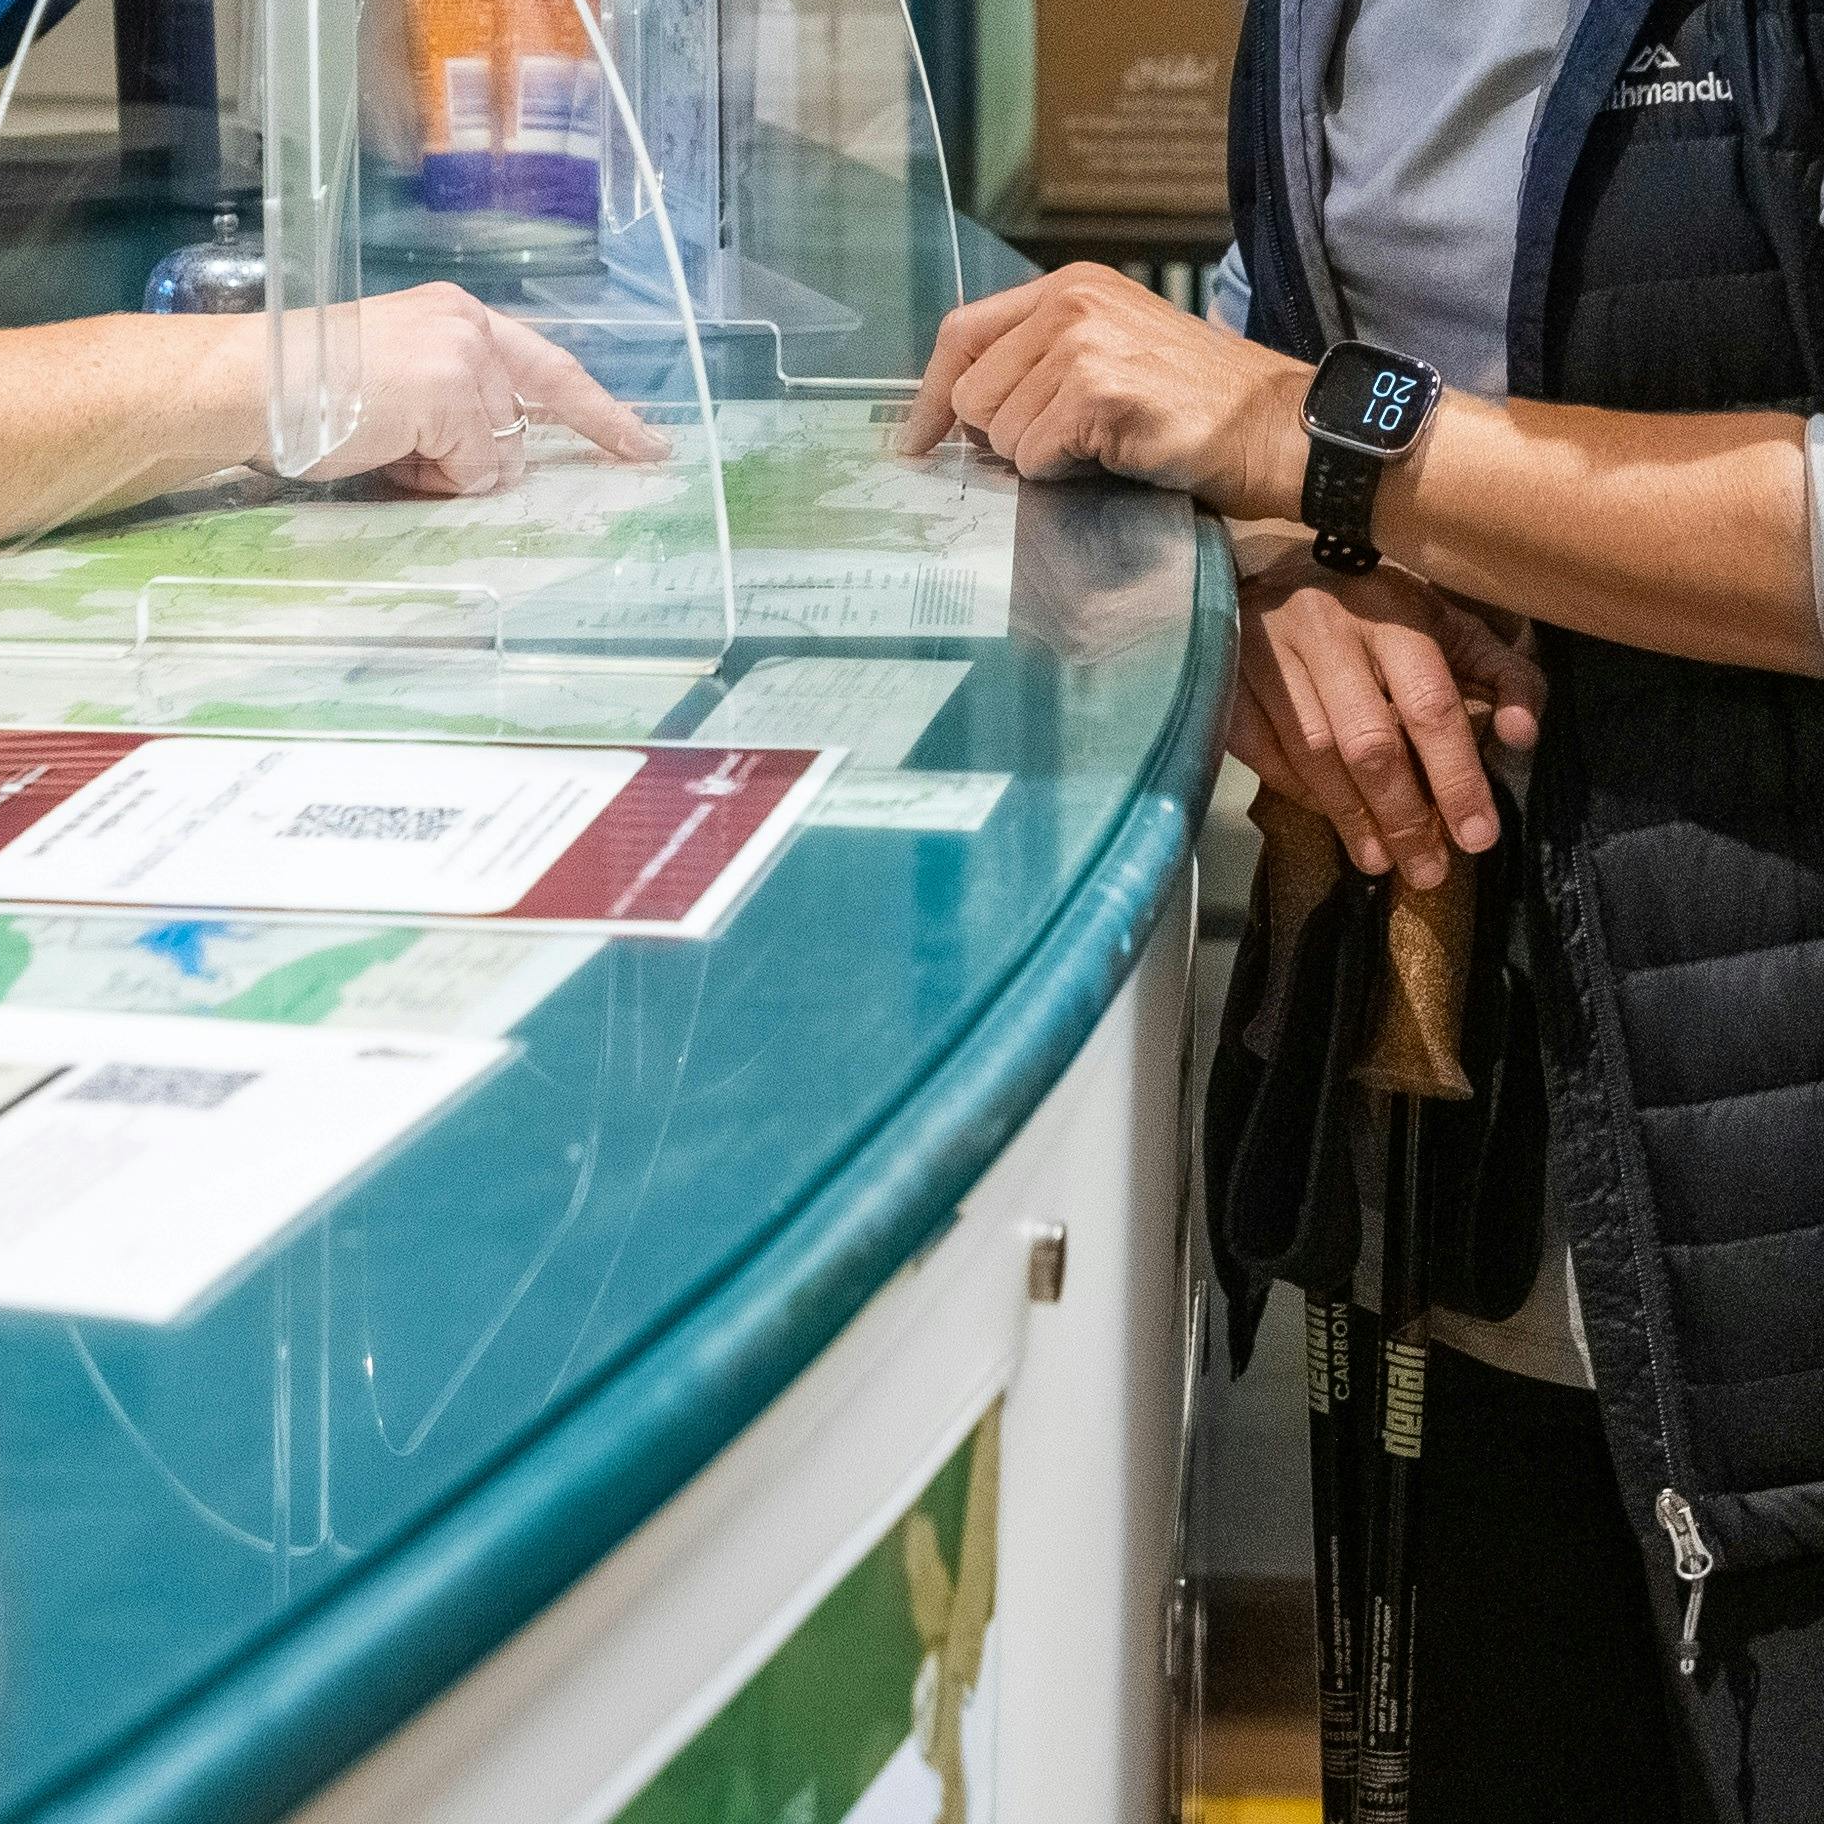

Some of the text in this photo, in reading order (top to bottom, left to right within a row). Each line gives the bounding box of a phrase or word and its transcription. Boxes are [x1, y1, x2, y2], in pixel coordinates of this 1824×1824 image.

[1611, 70, 1733, 110] thmandu
[1332, 1303, 1350, 1400] CARBON
[1381, 1340, 1426, 1459] denali
